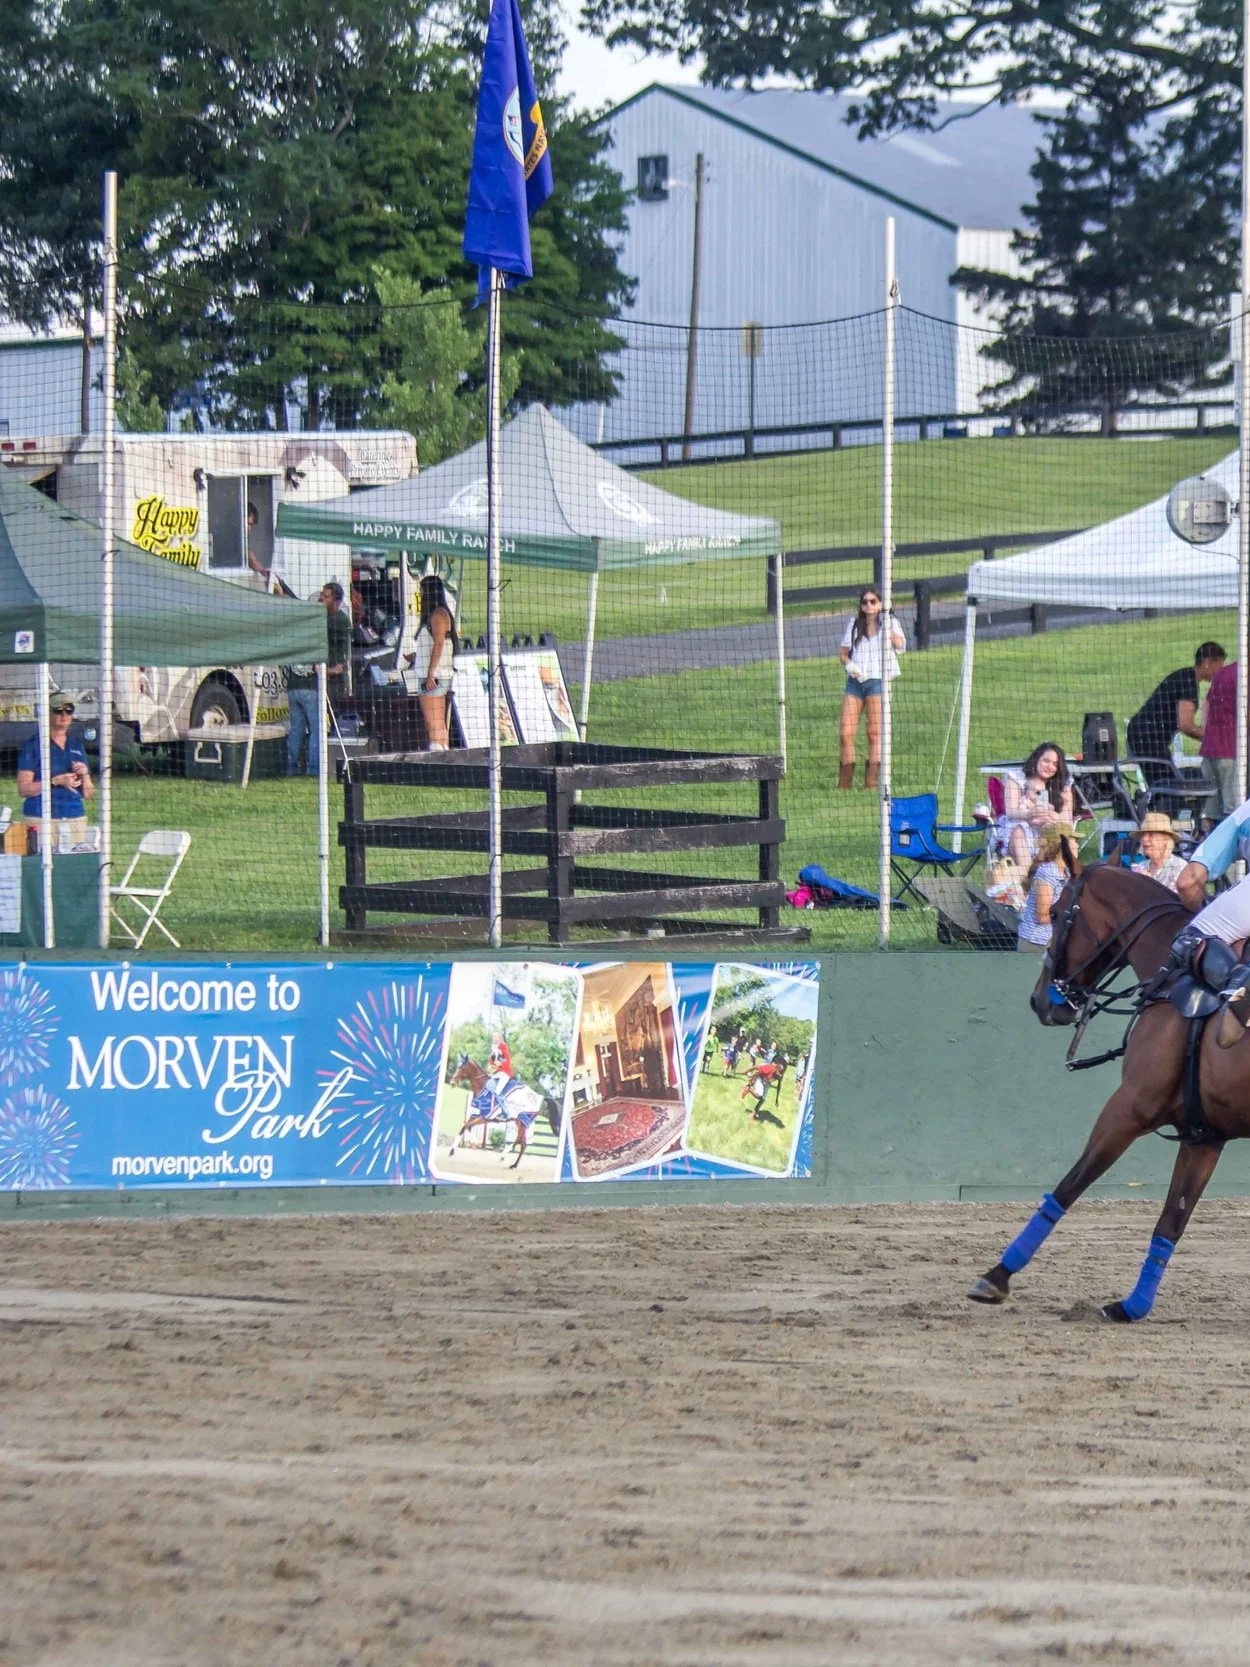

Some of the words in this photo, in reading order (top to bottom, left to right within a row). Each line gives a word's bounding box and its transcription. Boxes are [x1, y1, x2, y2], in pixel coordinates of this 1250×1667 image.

[134, 497, 198, 540] Happy
[353, 522, 402, 539] HAPPY
[406, 527, 459, 545] FAMILY
[645, 540, 676, 555] HAPPY
[677, 536, 706, 551] FAMILY
[91, 971, 256, 1011] Welcome
[267, 974, 300, 1011] to
[66, 1035, 295, 1089] MORVEN
[202, 1066, 353, 1143] Park
[112, 1151, 273, 1180] morvenpark.org
